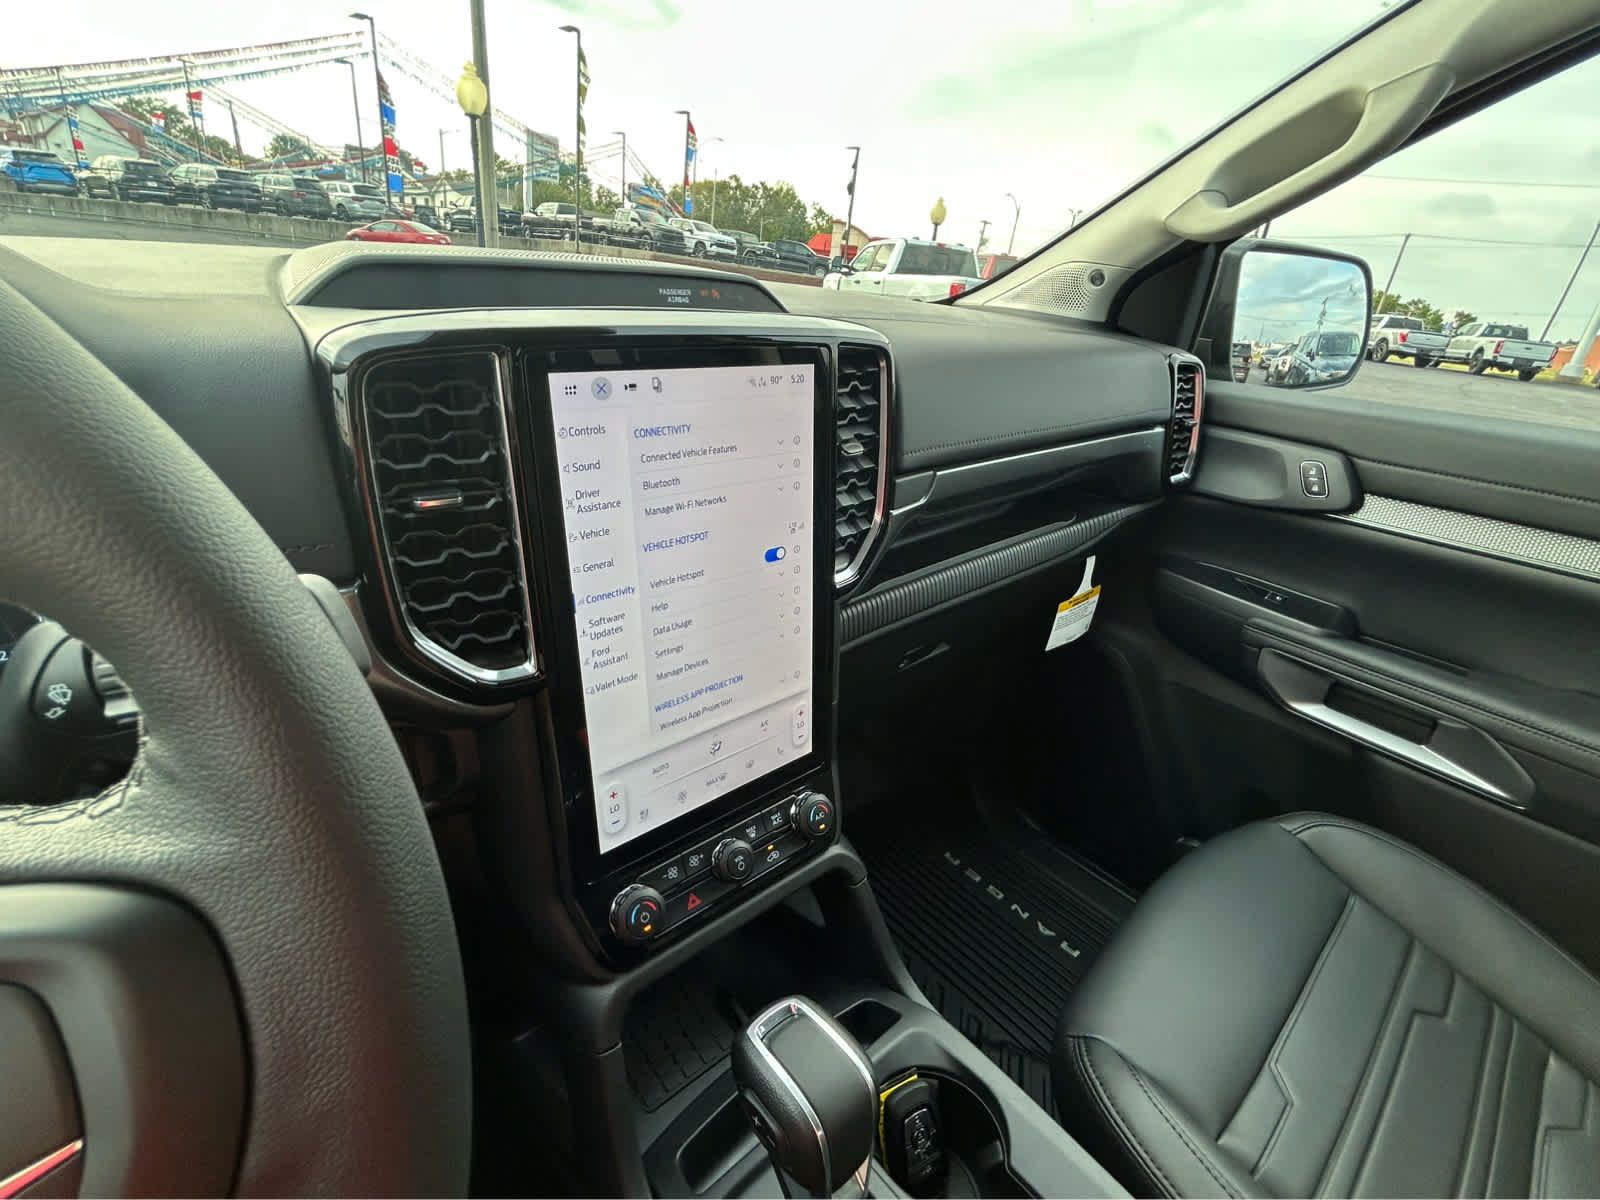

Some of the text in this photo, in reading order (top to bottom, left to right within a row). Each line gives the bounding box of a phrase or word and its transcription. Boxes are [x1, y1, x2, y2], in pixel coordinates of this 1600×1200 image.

[568, 424, 607, 437] Controls
[633, 424, 692, 439] CONNECTIVITY
[640, 443, 738, 464] Connected Vehicle Features
[572, 459, 601, 473] Sound
[642, 477, 681, 490] Bluetooth
[575, 488, 600, 501] Driver
[577, 500, 622, 514] Assistance
[644, 495, 727, 517] Manage Wi-Fi Networks
[579, 527, 610, 540] Vehicle
[642, 530, 710, 553] VEHICLE HOTSPOT
[582, 556, 615, 573] General
[650, 568, 705, 590] Vehicle Hotspot
[585, 584, 636, 605] Connectivity
[651, 601, 670, 613] Help
[588, 611, 626, 629] Software
[652, 619, 693, 637] Data Usage
[589, 625, 624, 641] Updates
[591, 645, 610, 659] Ford
[655, 644, 684, 660] Settings
[593, 652, 629, 670] Assistant
[656, 658, 709, 681] Manage Devices
[594, 671, 639, 693] Valet Mode
[655, 674, 744, 713] WIRELESS APP PROJECTION
[687, 709, 702, 721] App
[609, 803, 621, 815] LO
